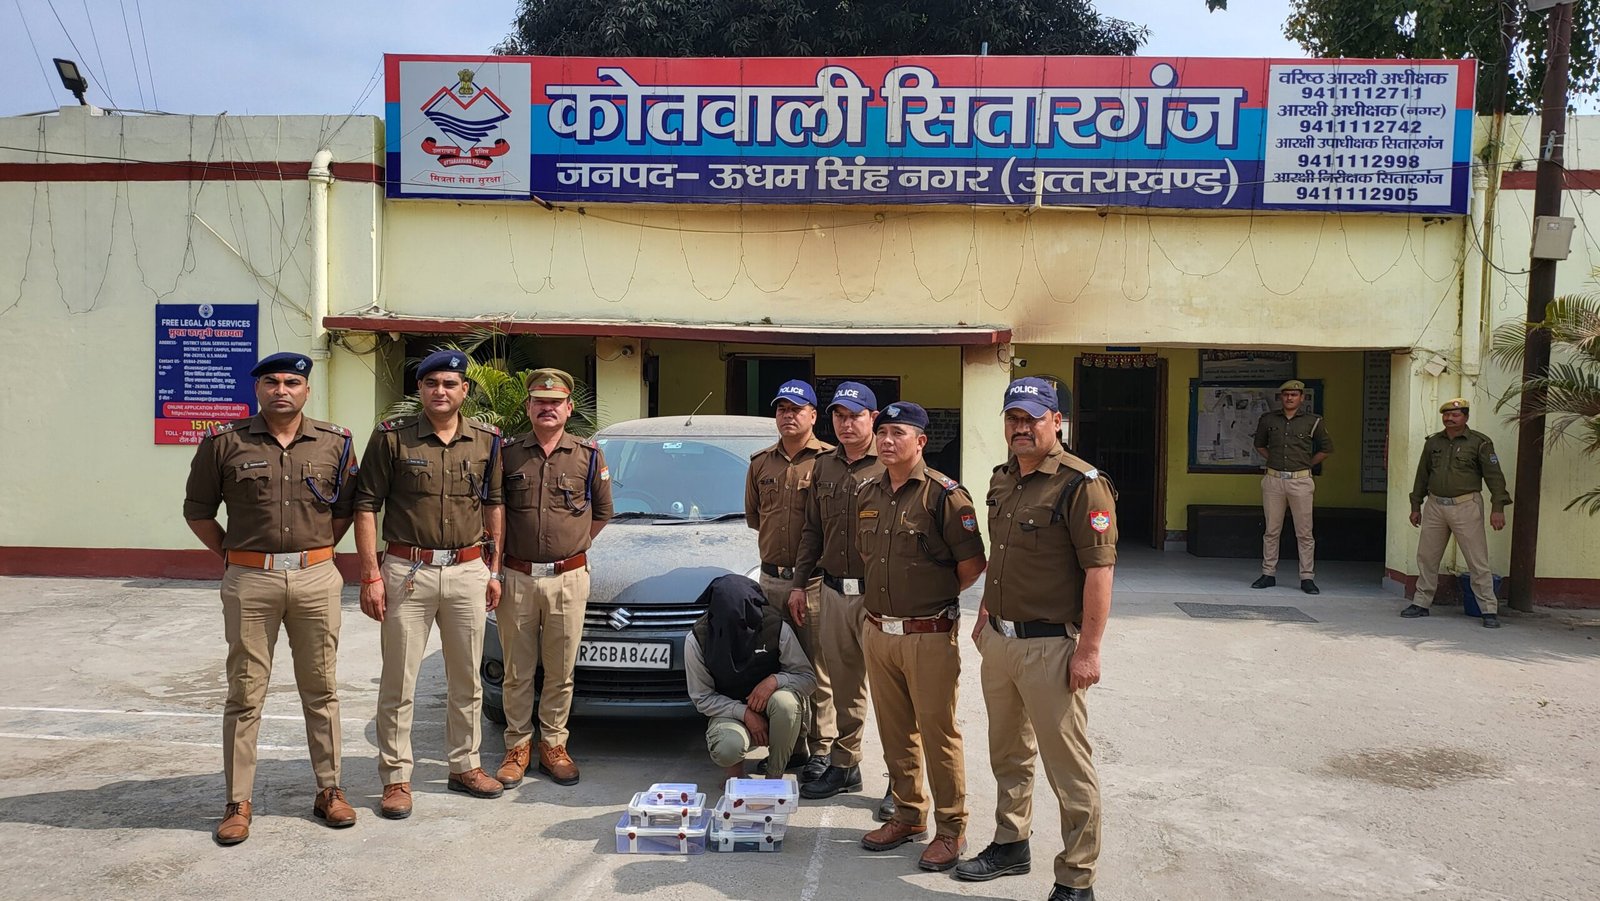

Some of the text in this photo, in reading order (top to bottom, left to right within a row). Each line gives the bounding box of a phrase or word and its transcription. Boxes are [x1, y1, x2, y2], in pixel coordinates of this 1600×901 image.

[1279, 69, 1449, 86] वरिष्ठ आरक्षी अधीक्षक
[1302, 87, 1422, 100] 9411112711
[545, 62, 1248, 148] कोतवाली सितारगंज
[1277, 101, 1446, 119] आरक्षी अधीक्षक (नगर)
[1300, 120, 1422, 134] 9411112742
[1275, 135, 1444, 150] आरक्षी उपाधीक्षक सितारगंज
[1298, 155, 1420, 168] 9411112998
[430, 173, 501, 186] मित्रता सेवा सुरक्षा
[556, 162, 699, 188] जनपद-
[708, 164, 809, 190] ऊधम
[815, 155, 894, 192] सिंह
[897, 166, 993, 192] नगर
[1273, 170, 1443, 184] आरक्षी निरीक्षक सितारगंज
[1296, 187, 1418, 201] 9411112905
[218, 320, 250, 328] SERVICES
[188, 328, 213, 339] कानूनी
[214, 329, 243, 337] सहायता
[835, 389, 859, 398] OLICE
[1010, 386, 1038, 395] POLICE
[580, 645, 668, 664] R26BA8444
